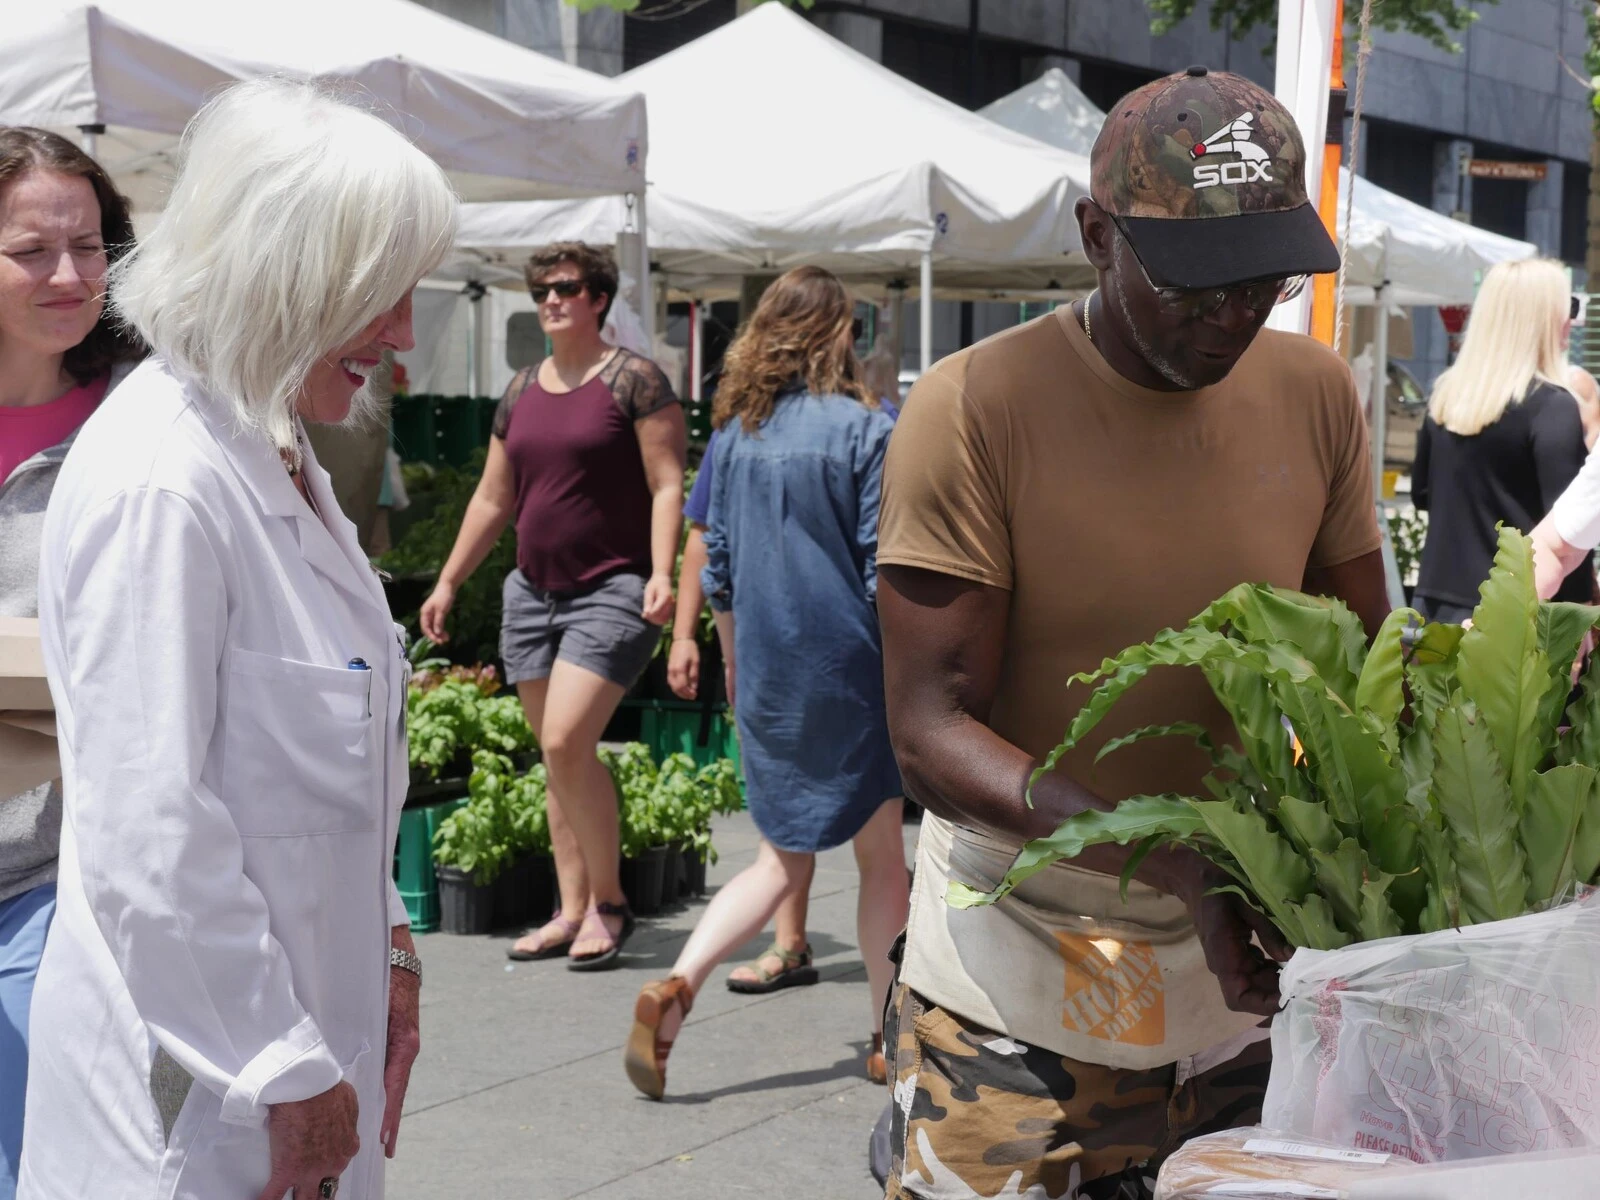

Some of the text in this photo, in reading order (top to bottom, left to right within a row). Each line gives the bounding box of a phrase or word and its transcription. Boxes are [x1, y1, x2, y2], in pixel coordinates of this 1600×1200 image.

[1193, 160, 1273, 189] SOX
[1103, 976, 1164, 1040] DEPOT
[1384, 968, 1548, 1047] THANK
[1557, 999, 1600, 1062] YO
[1360, 1110, 1394, 1131] Have
[1354, 1131, 1390, 1152] PLEASE
